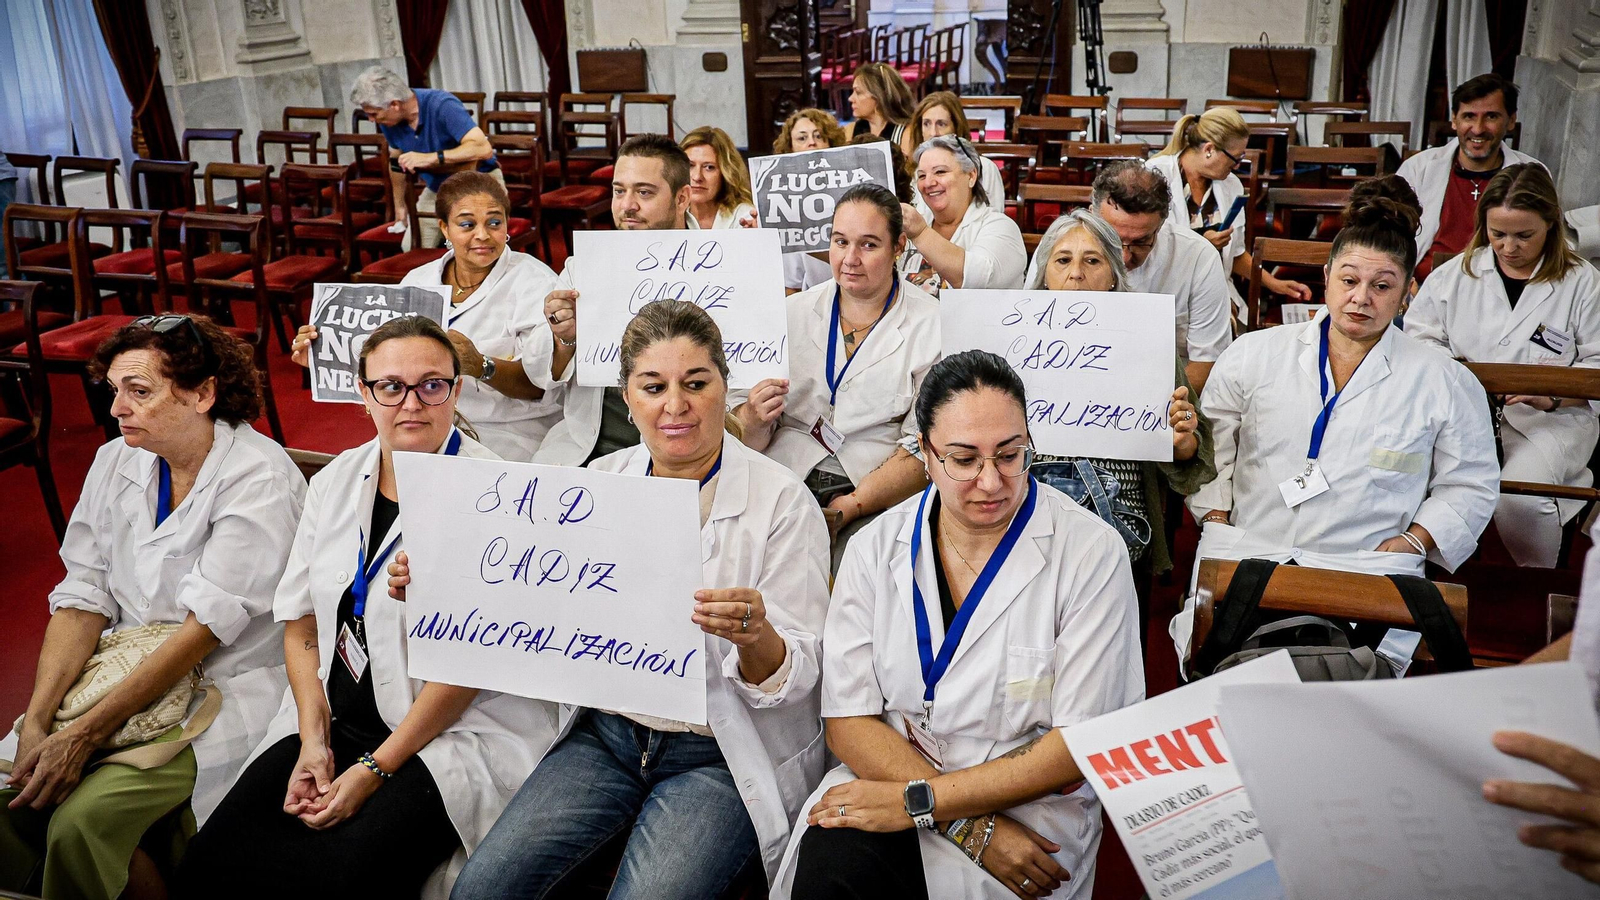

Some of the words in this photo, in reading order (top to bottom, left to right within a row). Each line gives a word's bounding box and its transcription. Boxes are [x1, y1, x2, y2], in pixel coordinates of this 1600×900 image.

[808, 158, 831, 169] LA
[769, 167, 874, 192] LUCHA
[765, 193, 835, 223] NO
[365, 294, 387, 306] LA
[324, 305, 418, 331] LUCH
[1026, 399, 1171, 432] PALIZACIÓN
[480, 536, 618, 593] CADIZ
[1086, 715, 1230, 791] MENT
[1122, 803, 1166, 830] DIARIO
[1161, 796, 1180, 813] DE
[1142, 846, 1177, 867] Bruno
